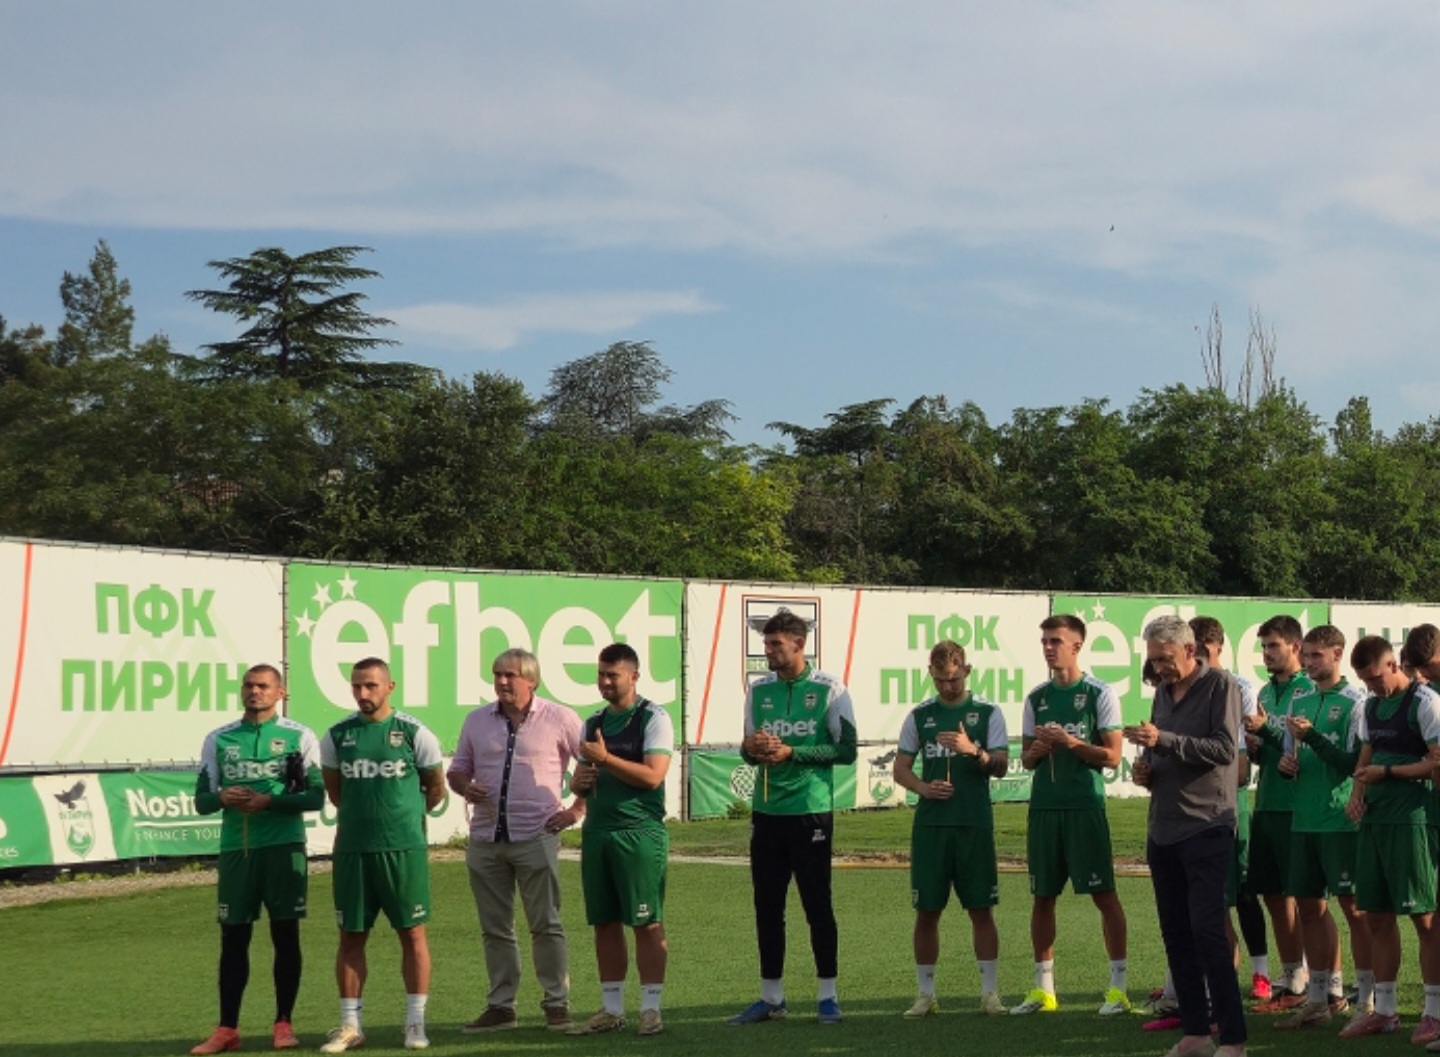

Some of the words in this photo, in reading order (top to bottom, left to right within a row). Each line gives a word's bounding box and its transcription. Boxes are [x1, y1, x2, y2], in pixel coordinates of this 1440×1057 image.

[95, 581, 217, 638] ПФК
[311, 581, 678, 711] efbet
[907, 614, 1000, 652] ПФК
[61, 660, 249, 711] ПИРИН
[880, 668, 1025, 705] ПИИН
[340, 758, 407, 779] efbet
